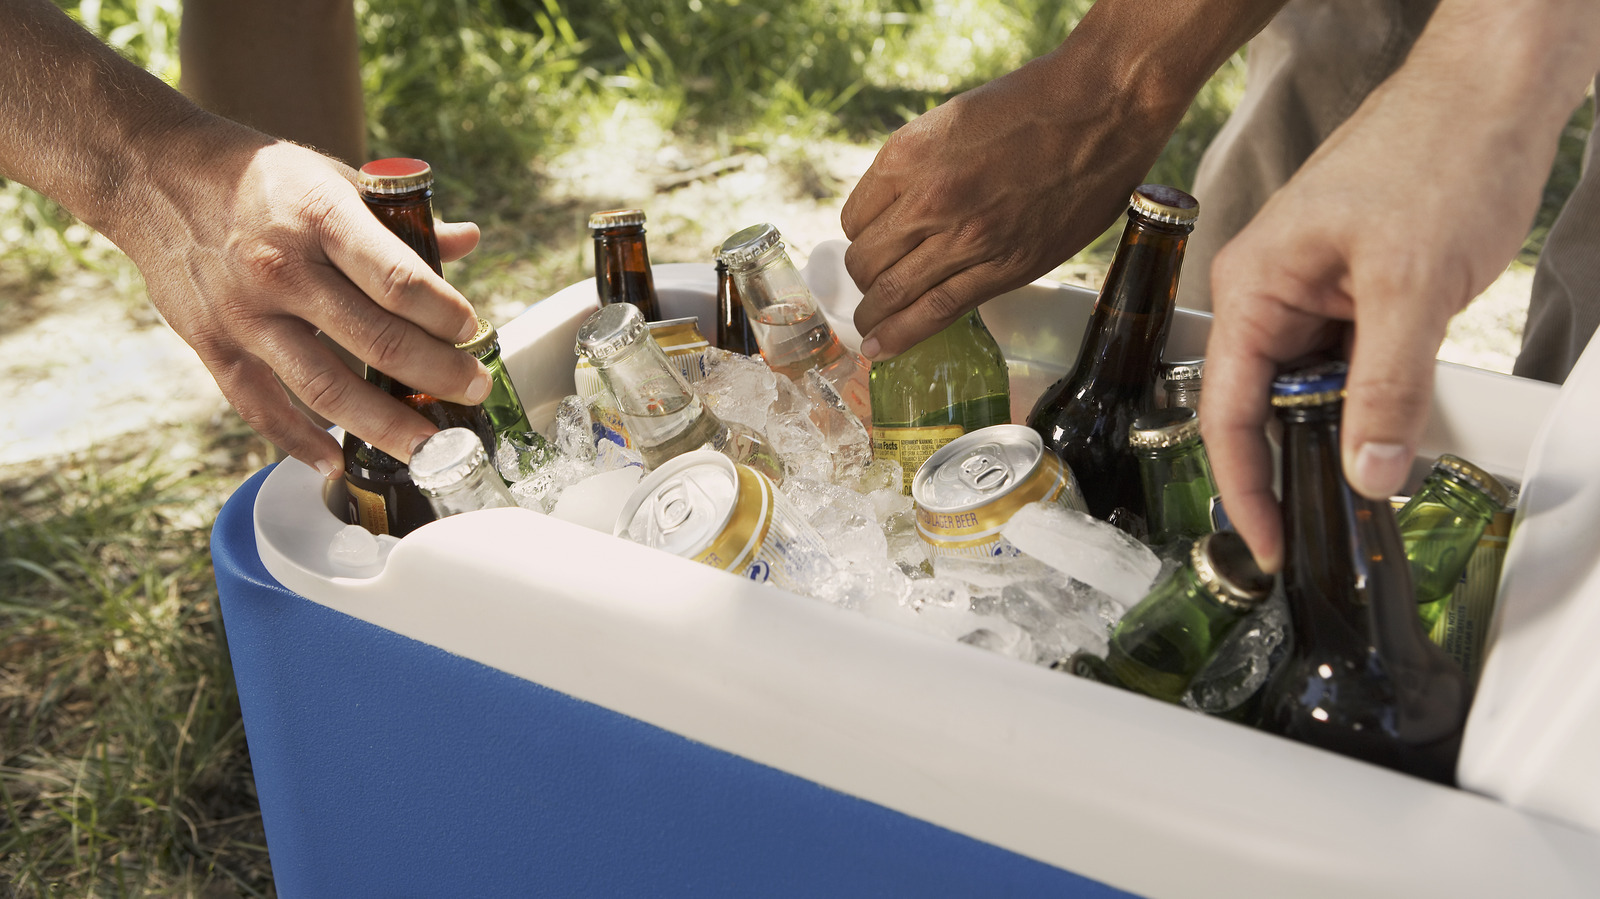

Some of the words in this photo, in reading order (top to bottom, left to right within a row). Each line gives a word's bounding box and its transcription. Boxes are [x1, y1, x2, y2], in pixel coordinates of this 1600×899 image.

[883, 441, 898, 451] Facts
[932, 514, 954, 529] LAGER
[955, 512, 979, 529] BEER
[1448, 611, 1456, 625] NOT
